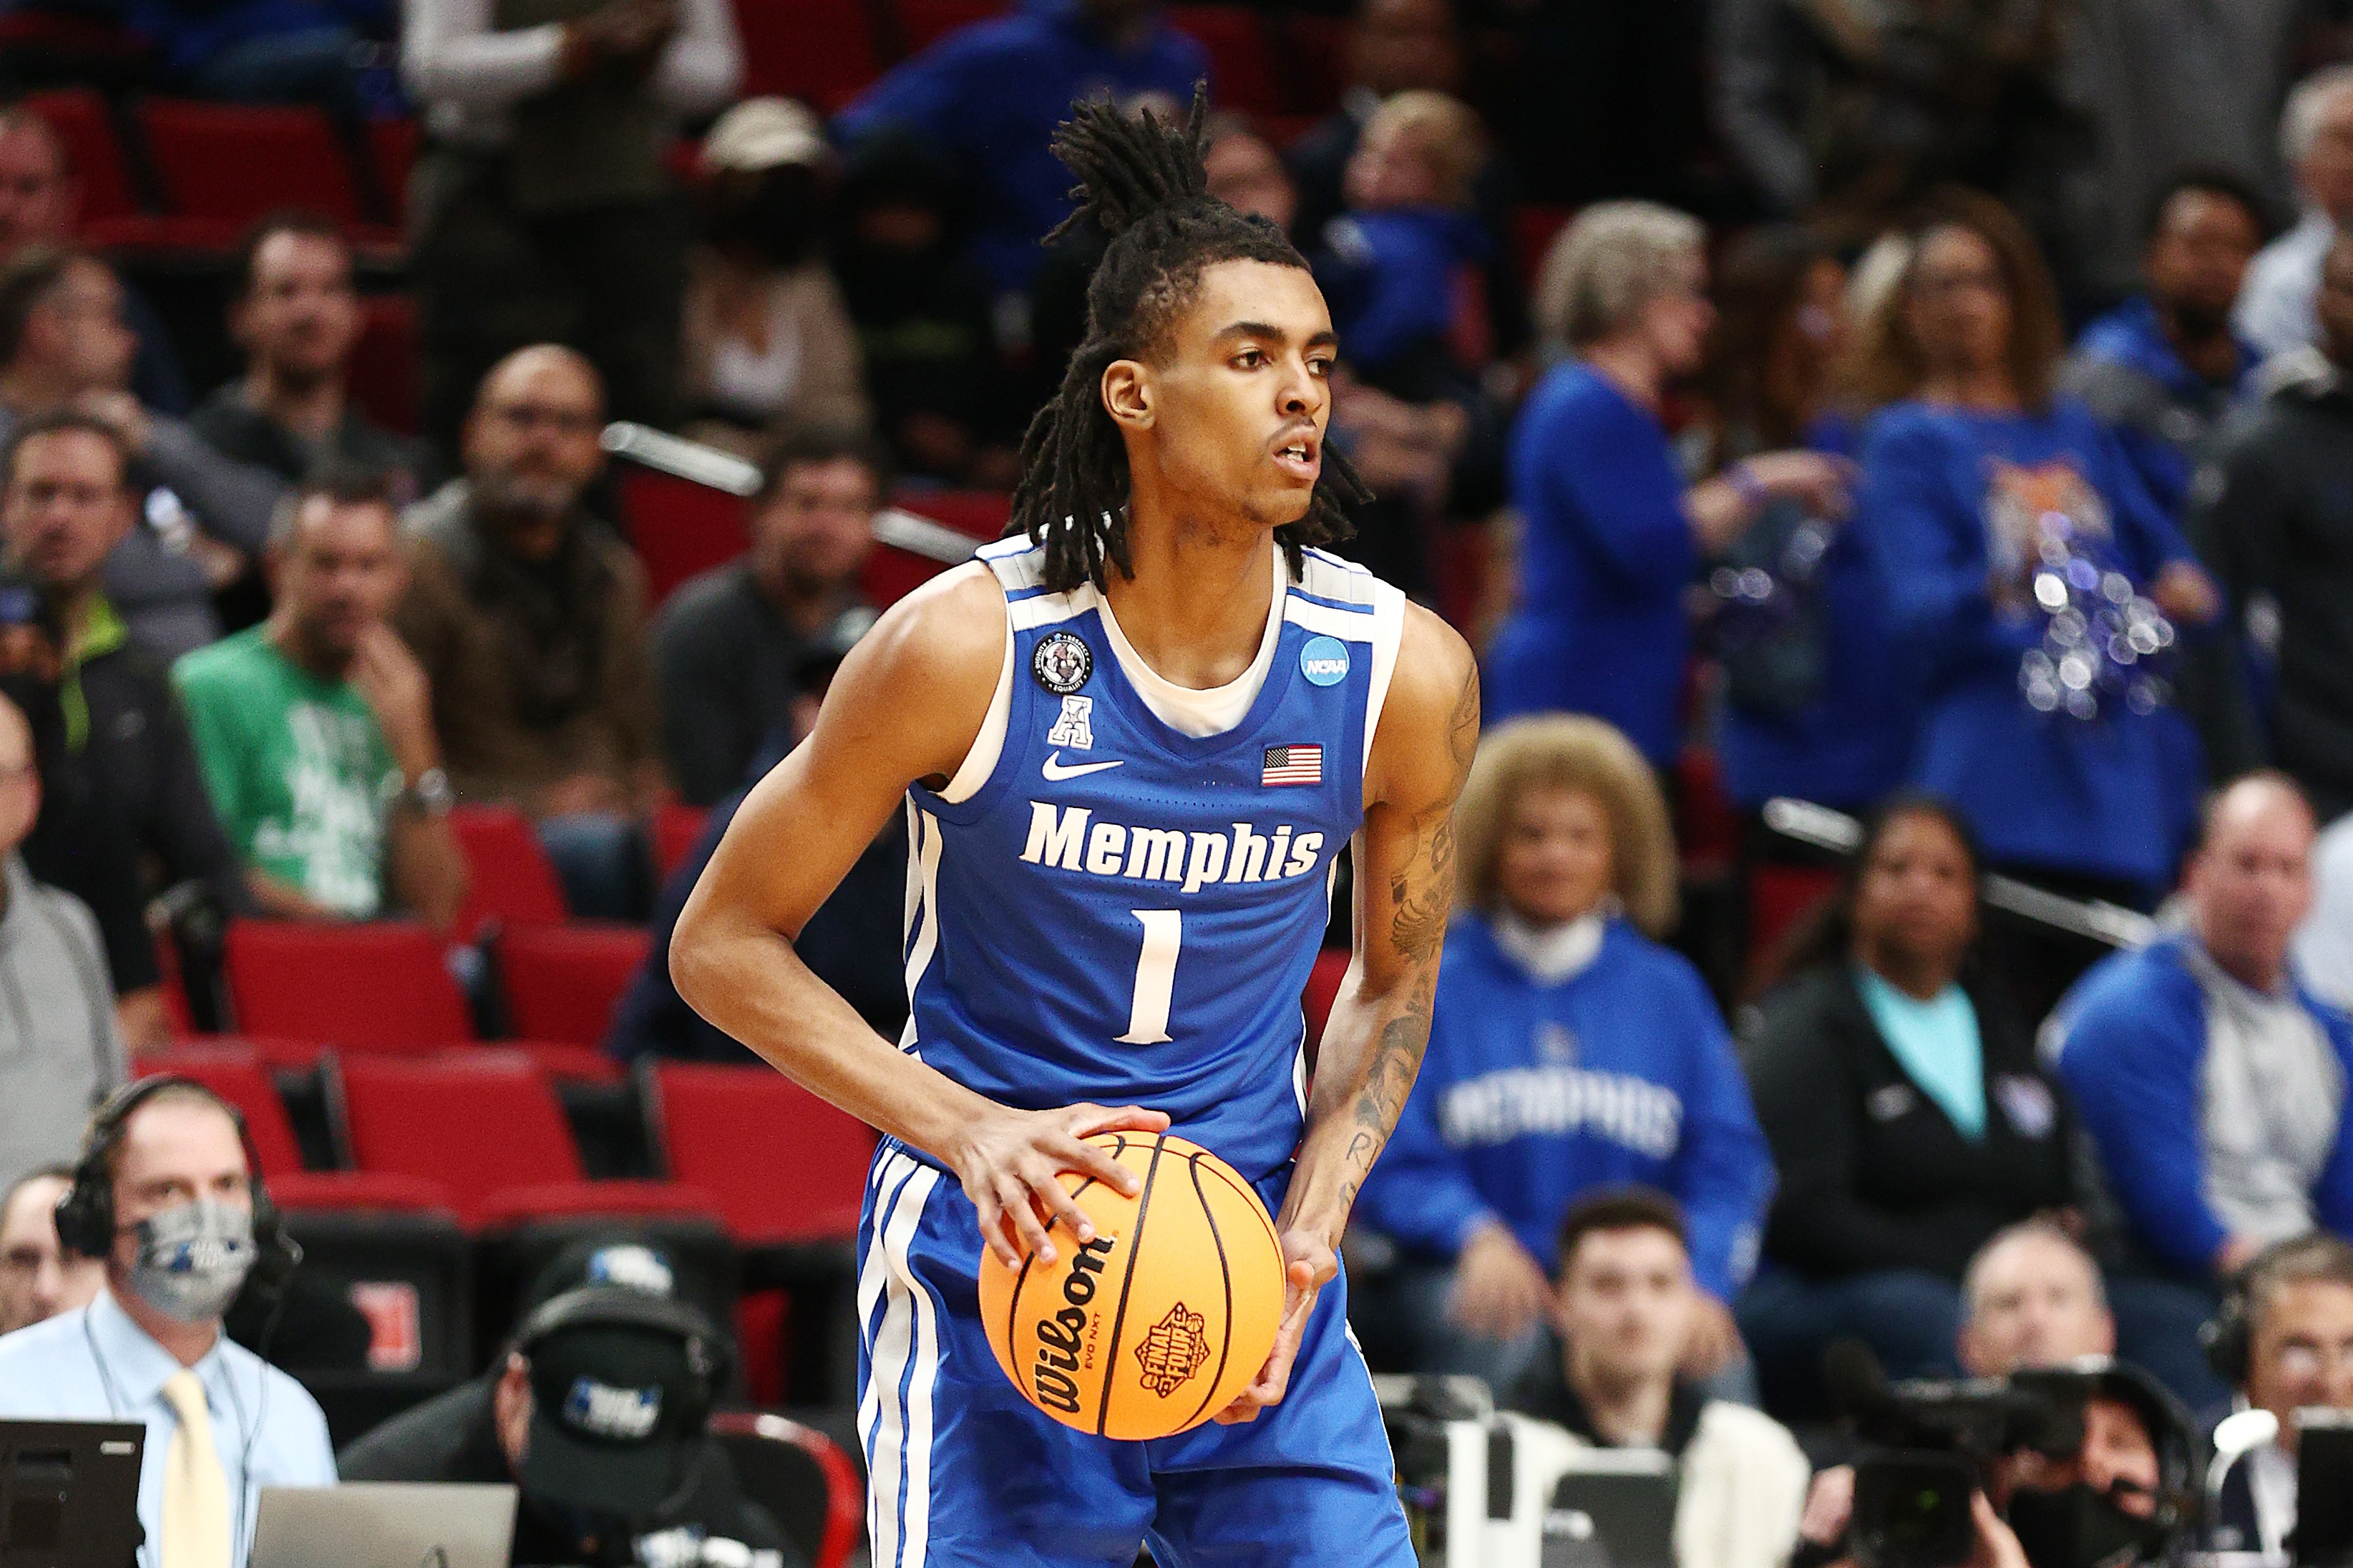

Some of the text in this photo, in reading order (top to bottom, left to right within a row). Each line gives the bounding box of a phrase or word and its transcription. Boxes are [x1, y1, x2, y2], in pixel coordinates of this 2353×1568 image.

[1035, 642, 1048, 669] DIGNITY
[1306, 659, 1348, 675] NCAA
[1019, 800, 1324, 893] Memphis
[1112, 909, 1182, 1045] 1
[1033, 1234, 1115, 1414] Wilson
[1085, 1311, 1101, 1370] EVO NXT
[1144, 1325, 1171, 1375] FINAL
[1165, 1327, 1193, 1378] FOUR
